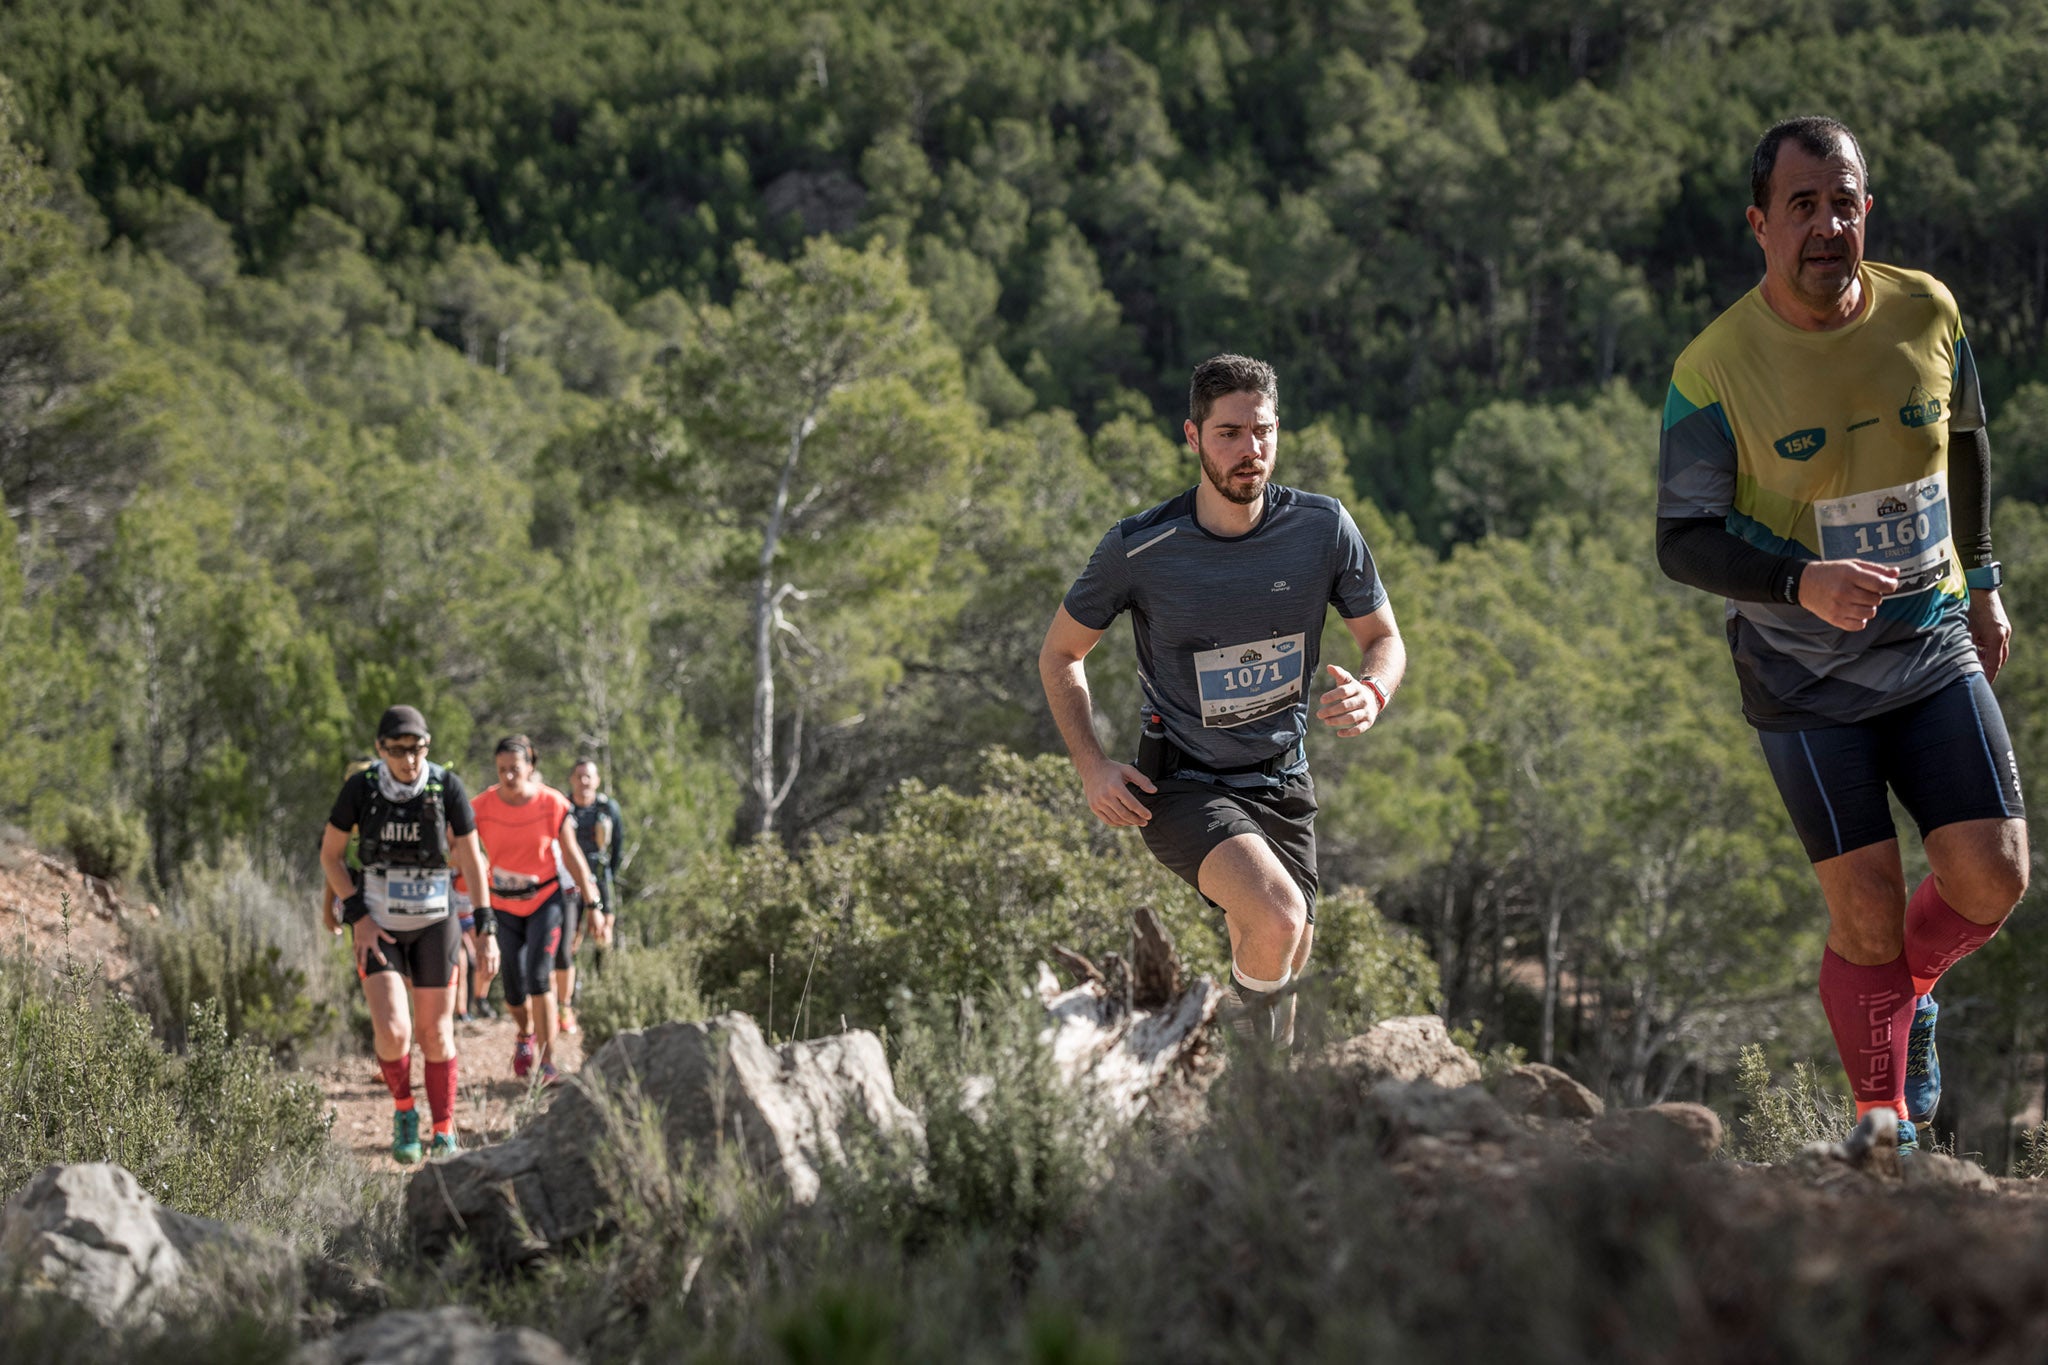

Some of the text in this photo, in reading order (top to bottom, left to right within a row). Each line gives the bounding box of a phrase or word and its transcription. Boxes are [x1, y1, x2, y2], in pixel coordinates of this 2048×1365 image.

[1903, 402, 1941, 421] TRAIL
[1784, 434, 1818, 454] 15K
[1854, 513, 1930, 554] 1160
[1223, 662, 1283, 691] 1071
[1859, 989, 1900, 1092] Kalenji
